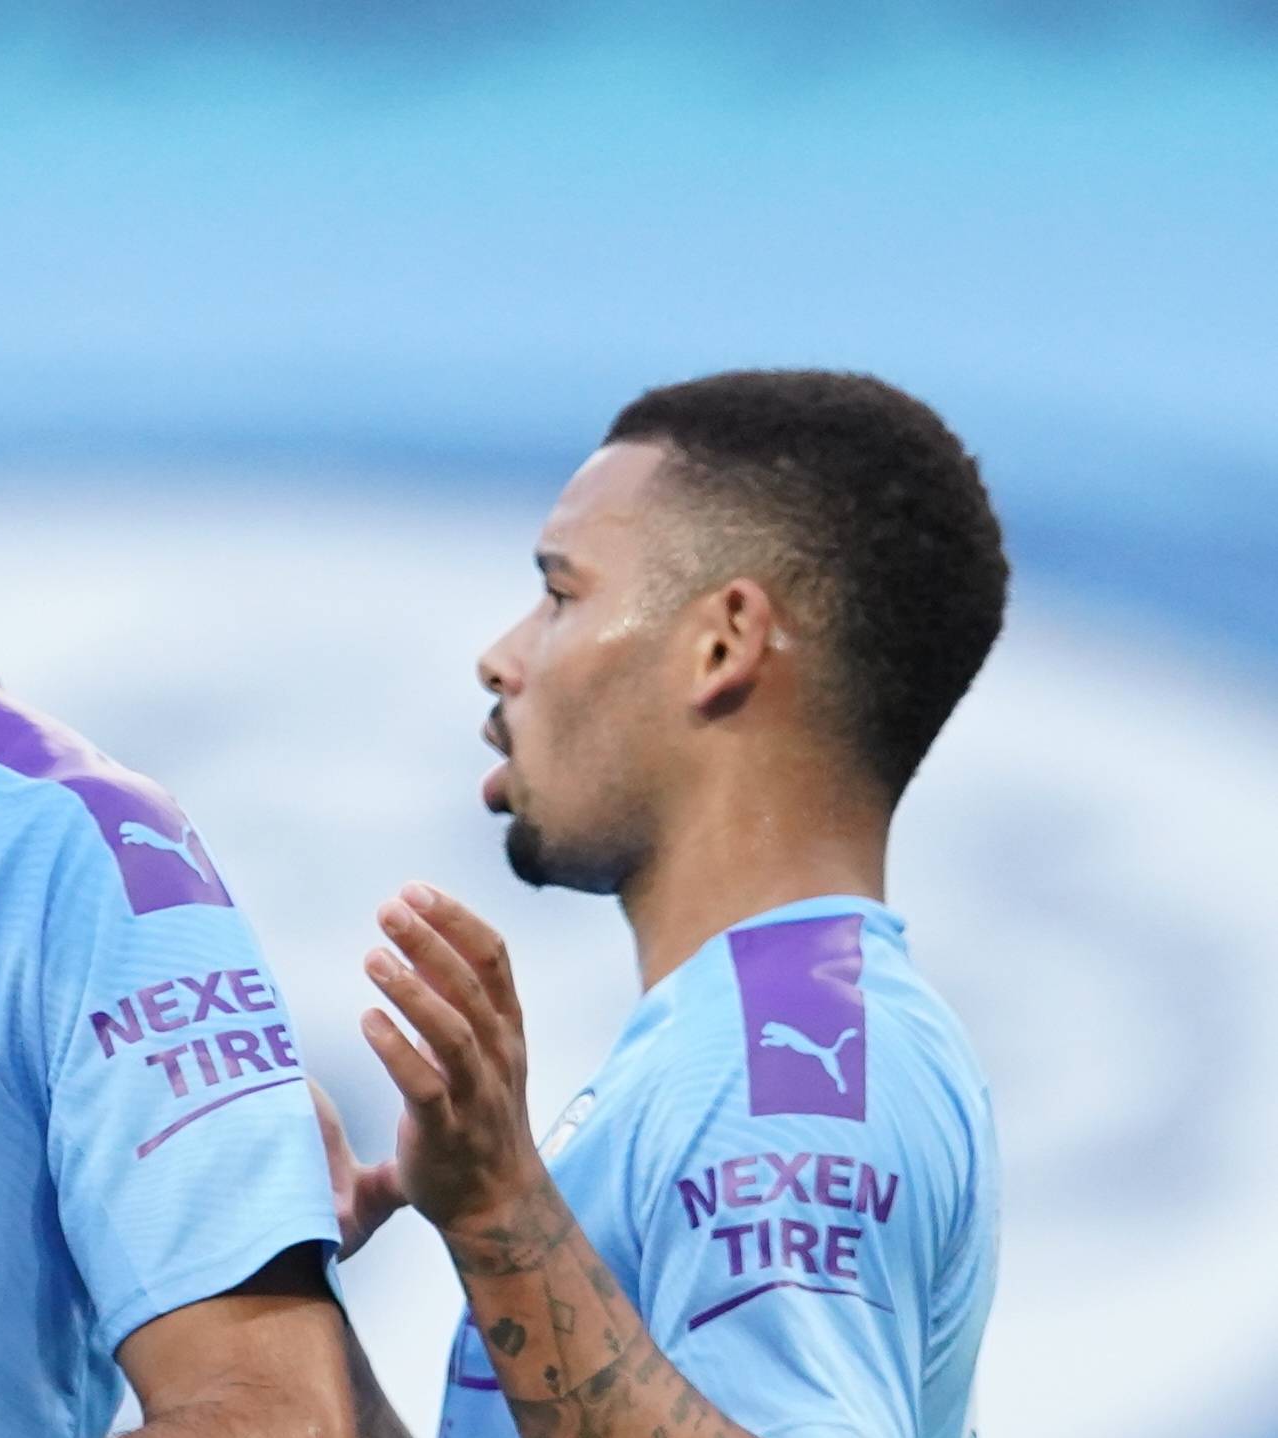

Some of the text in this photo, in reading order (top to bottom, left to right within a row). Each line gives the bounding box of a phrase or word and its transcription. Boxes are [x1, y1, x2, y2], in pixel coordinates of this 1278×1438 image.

[88, 968, 276, 1059] NEXE
[145, 1023, 299, 1098] TIRE
[676, 1152, 899, 1229] NEXEN
[712, 1218, 862, 1280] TIRE
